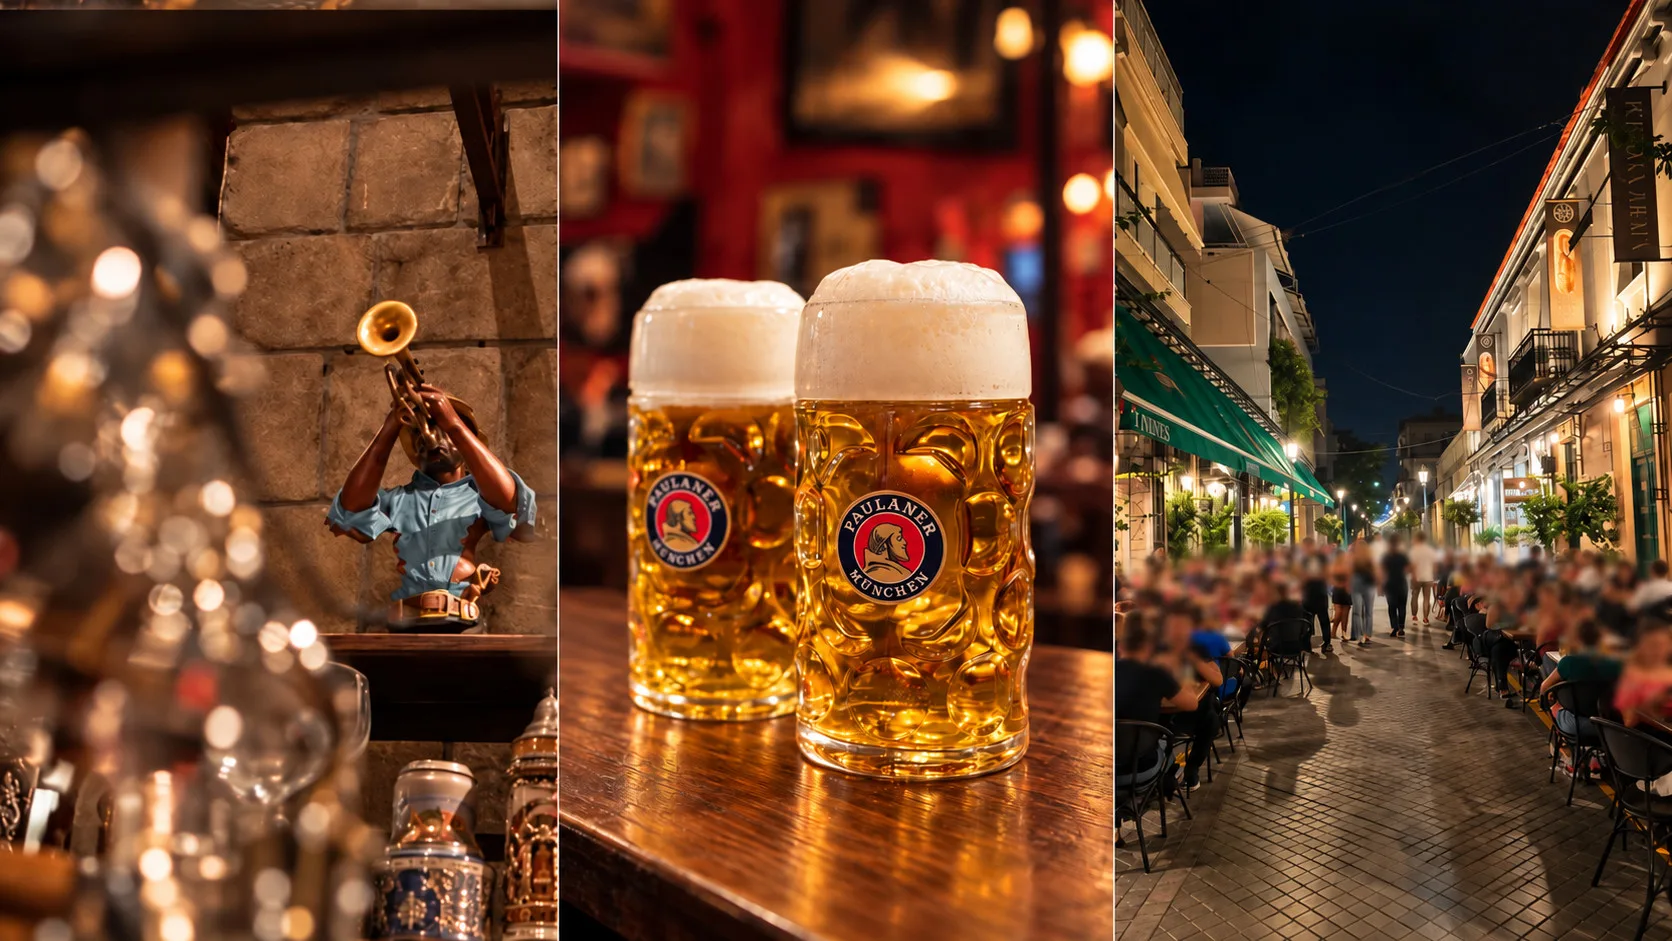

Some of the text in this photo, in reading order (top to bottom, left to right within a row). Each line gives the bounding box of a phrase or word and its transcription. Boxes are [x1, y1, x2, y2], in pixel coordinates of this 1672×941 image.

[649, 477, 722, 513] PAULANER
[844, 498, 936, 537] PAULANER
[849, 569, 929, 598] MÜNCHEN
